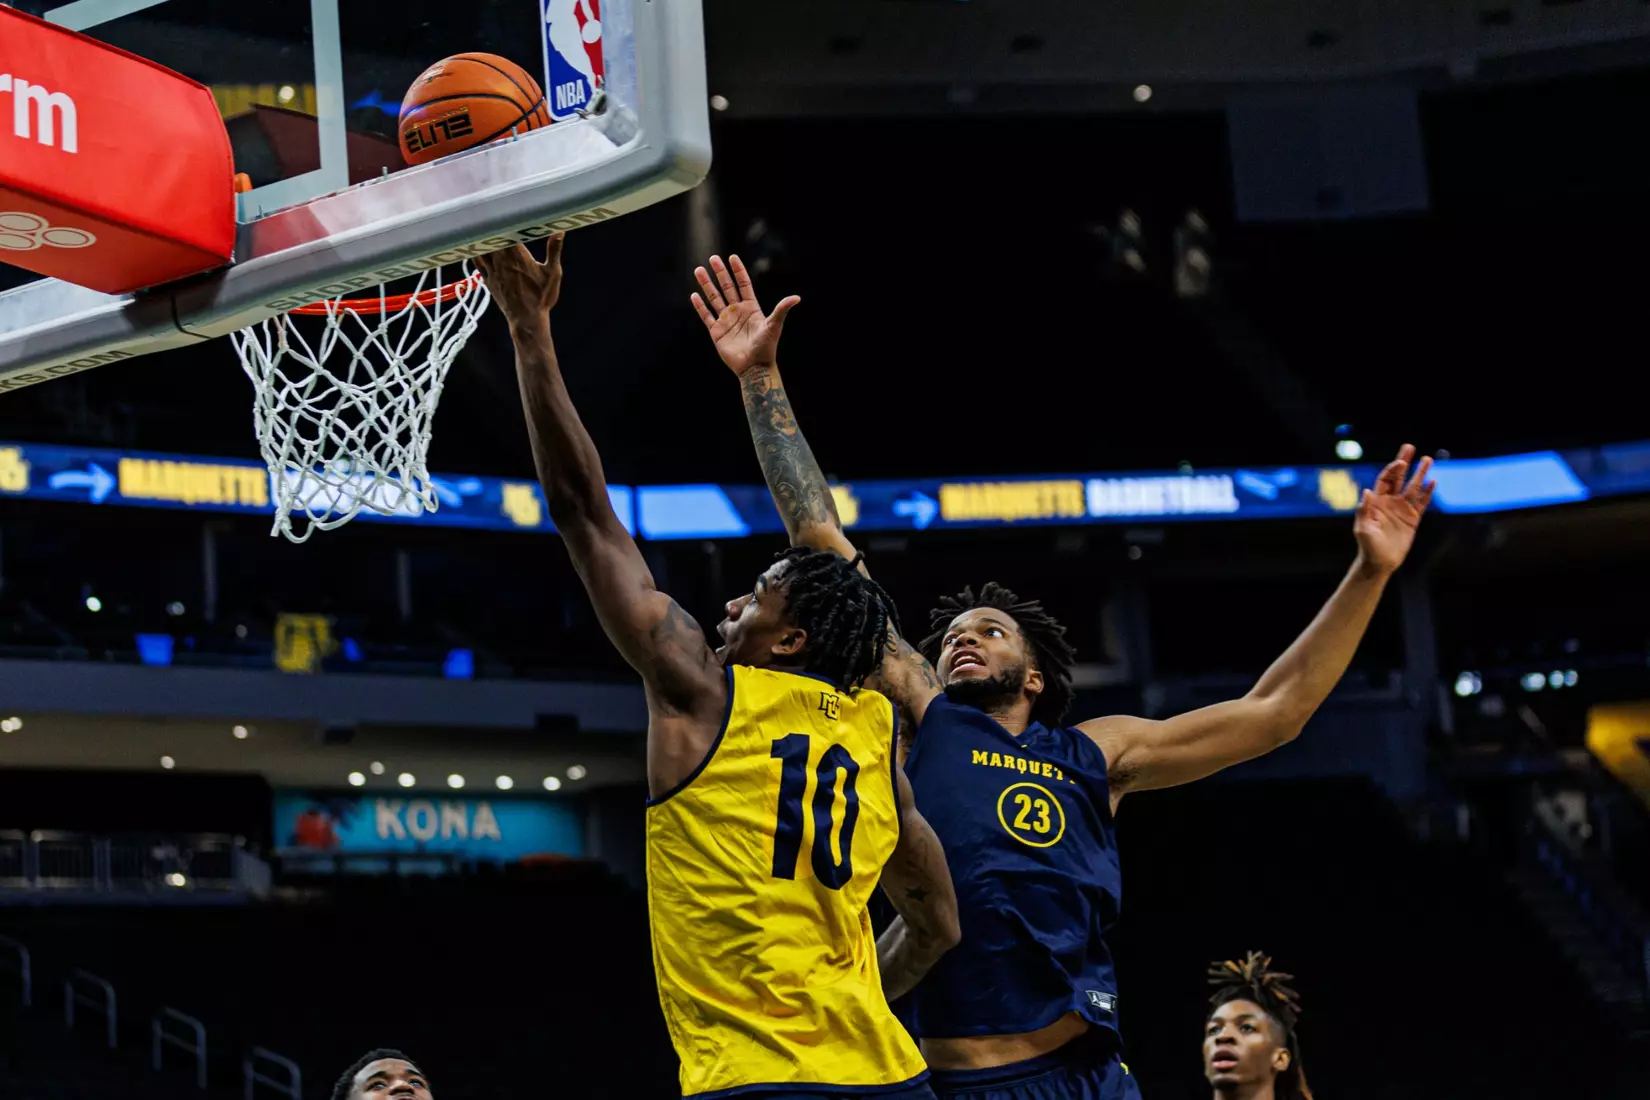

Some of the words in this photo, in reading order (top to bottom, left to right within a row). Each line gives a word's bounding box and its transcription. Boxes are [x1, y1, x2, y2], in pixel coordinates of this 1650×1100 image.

[555, 79, 587, 110] NBA
[404, 113, 473, 154] ELITE
[376, 798, 501, 841] KONA
[770, 732, 861, 891] 10
[1013, 793, 1052, 834] 23
